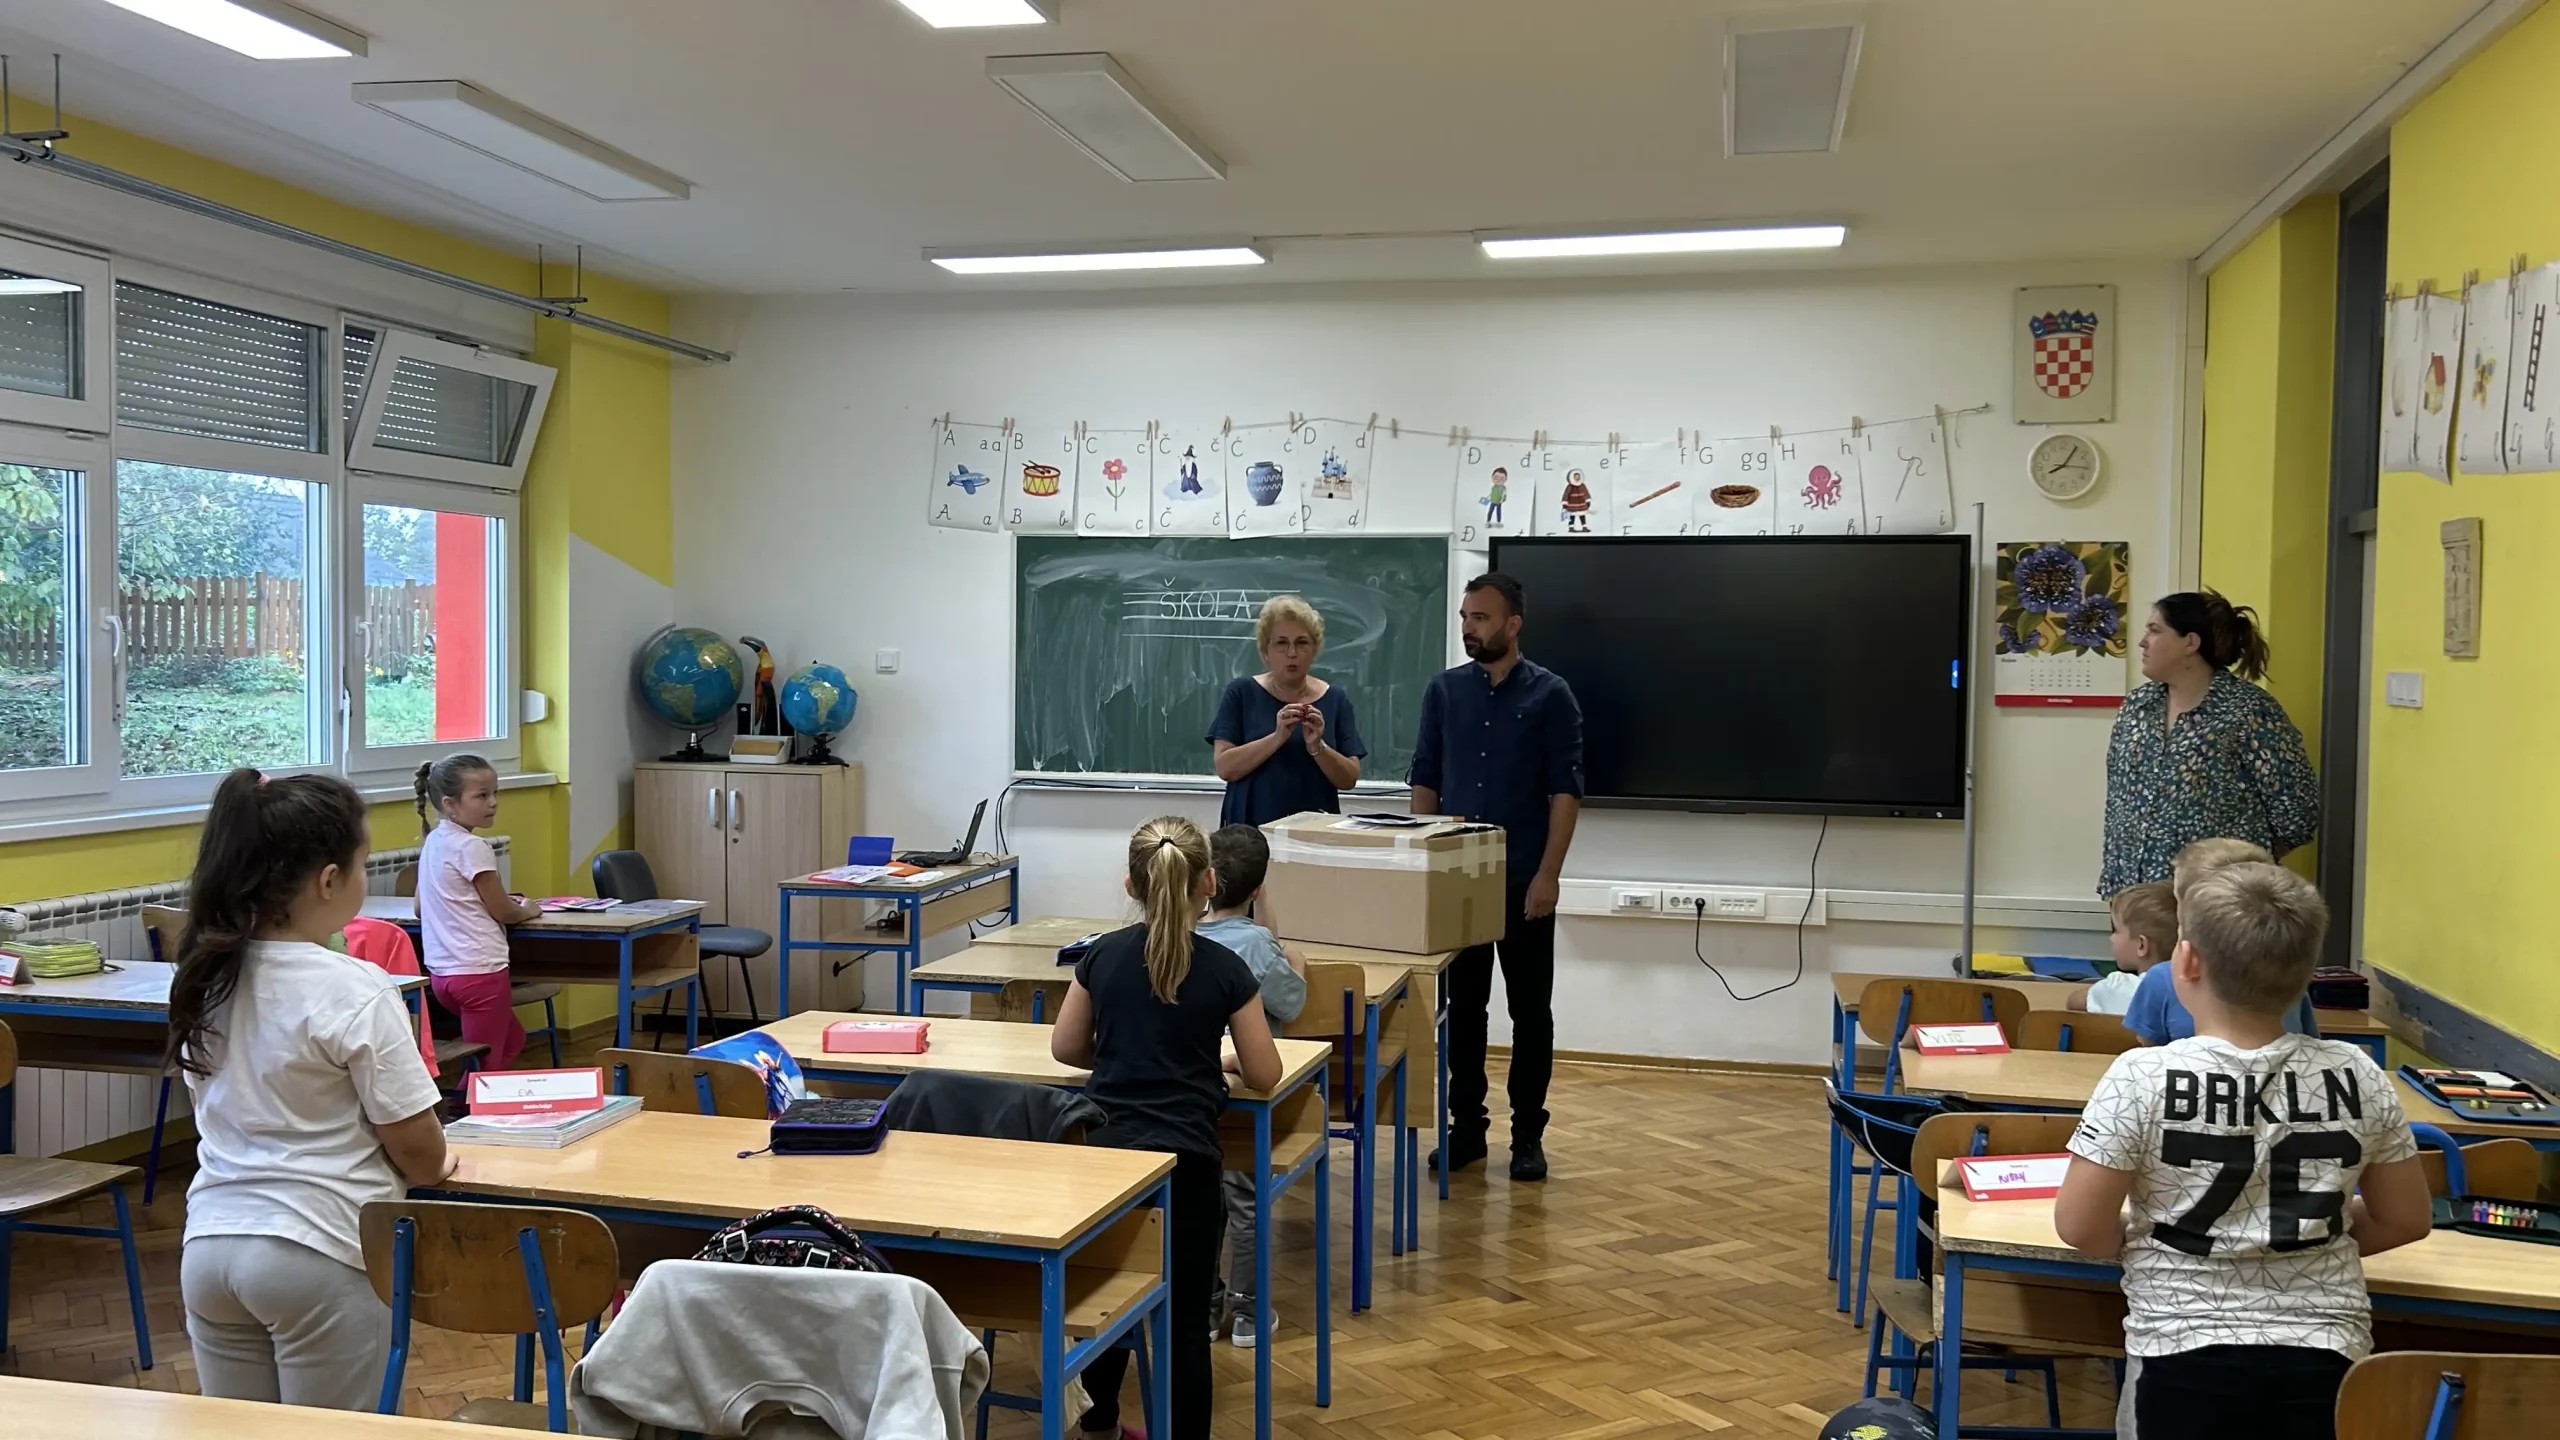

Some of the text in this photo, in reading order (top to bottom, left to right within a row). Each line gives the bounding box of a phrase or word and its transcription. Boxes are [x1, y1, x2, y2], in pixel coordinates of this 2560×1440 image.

[944, 430, 1001, 452] A a a
[1014, 433, 1072, 452] B b
[1086, 437, 1098, 454] C
[1160, 433, 1219, 454] Č č
[1231, 436, 1292, 457] Ć ć
[1304, 427, 1366, 448] D d
[1468, 447, 1482, 465] Đ
[1619, 448, 1687, 467] F f
[1699, 447, 1767, 472] G g g
[1782, 437, 1852, 461] H h
[1543, 453, 1609, 471] E e
[936, 504, 992, 525] A a
[1010, 508, 1022, 524] B
[1160, 507, 1220, 528] Č č
[1236, 509, 1296, 531] Ć ć
[1348, 509, 1359, 527] d
[1160, 576, 1251, 620] ŠKOLA
[1931, 1032, 1964, 1044] VITO
[518, 1088, 535, 1097] EVA
[2164, 1068, 2362, 1127] BRKLN
[2150, 1129, 2362, 1257] 76
